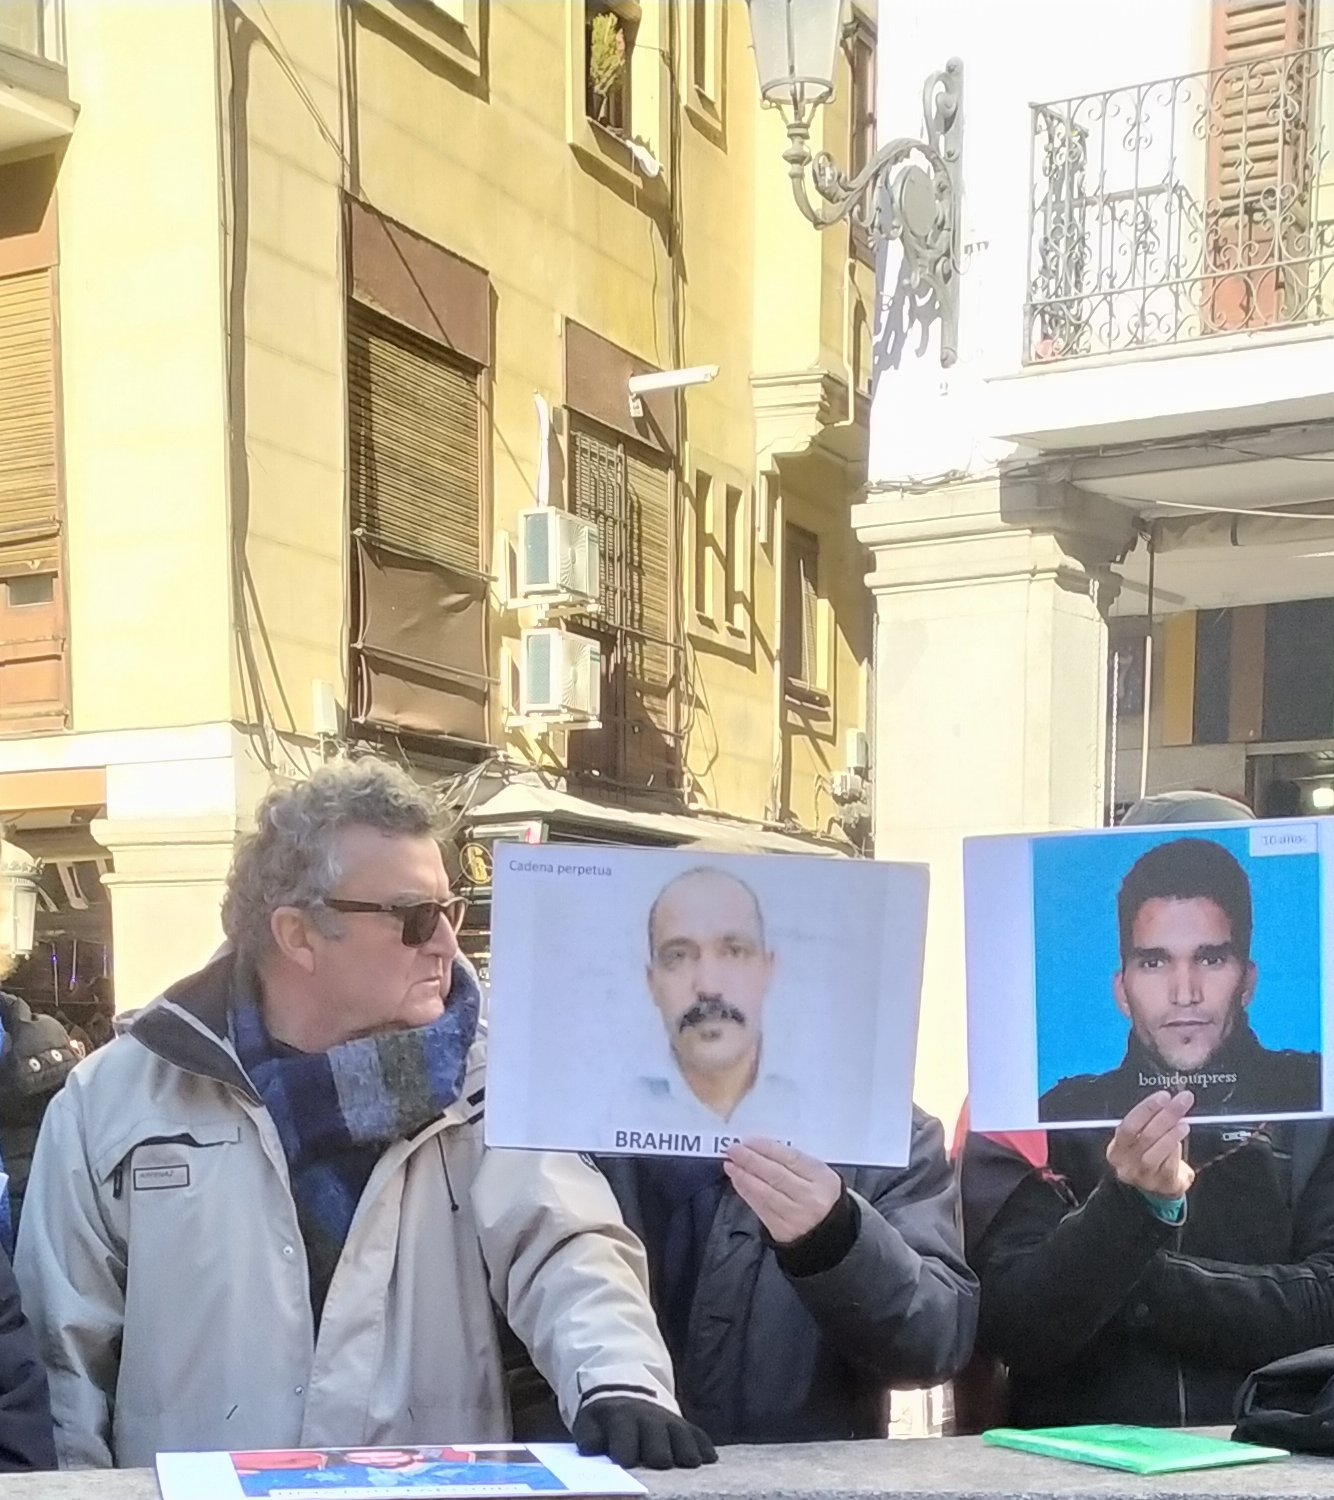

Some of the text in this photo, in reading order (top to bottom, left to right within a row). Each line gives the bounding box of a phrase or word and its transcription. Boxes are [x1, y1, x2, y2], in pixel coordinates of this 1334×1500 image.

[509, 860, 612, 877] Cadena perpetua
[615, 1130, 701, 1152] BRAHIM
